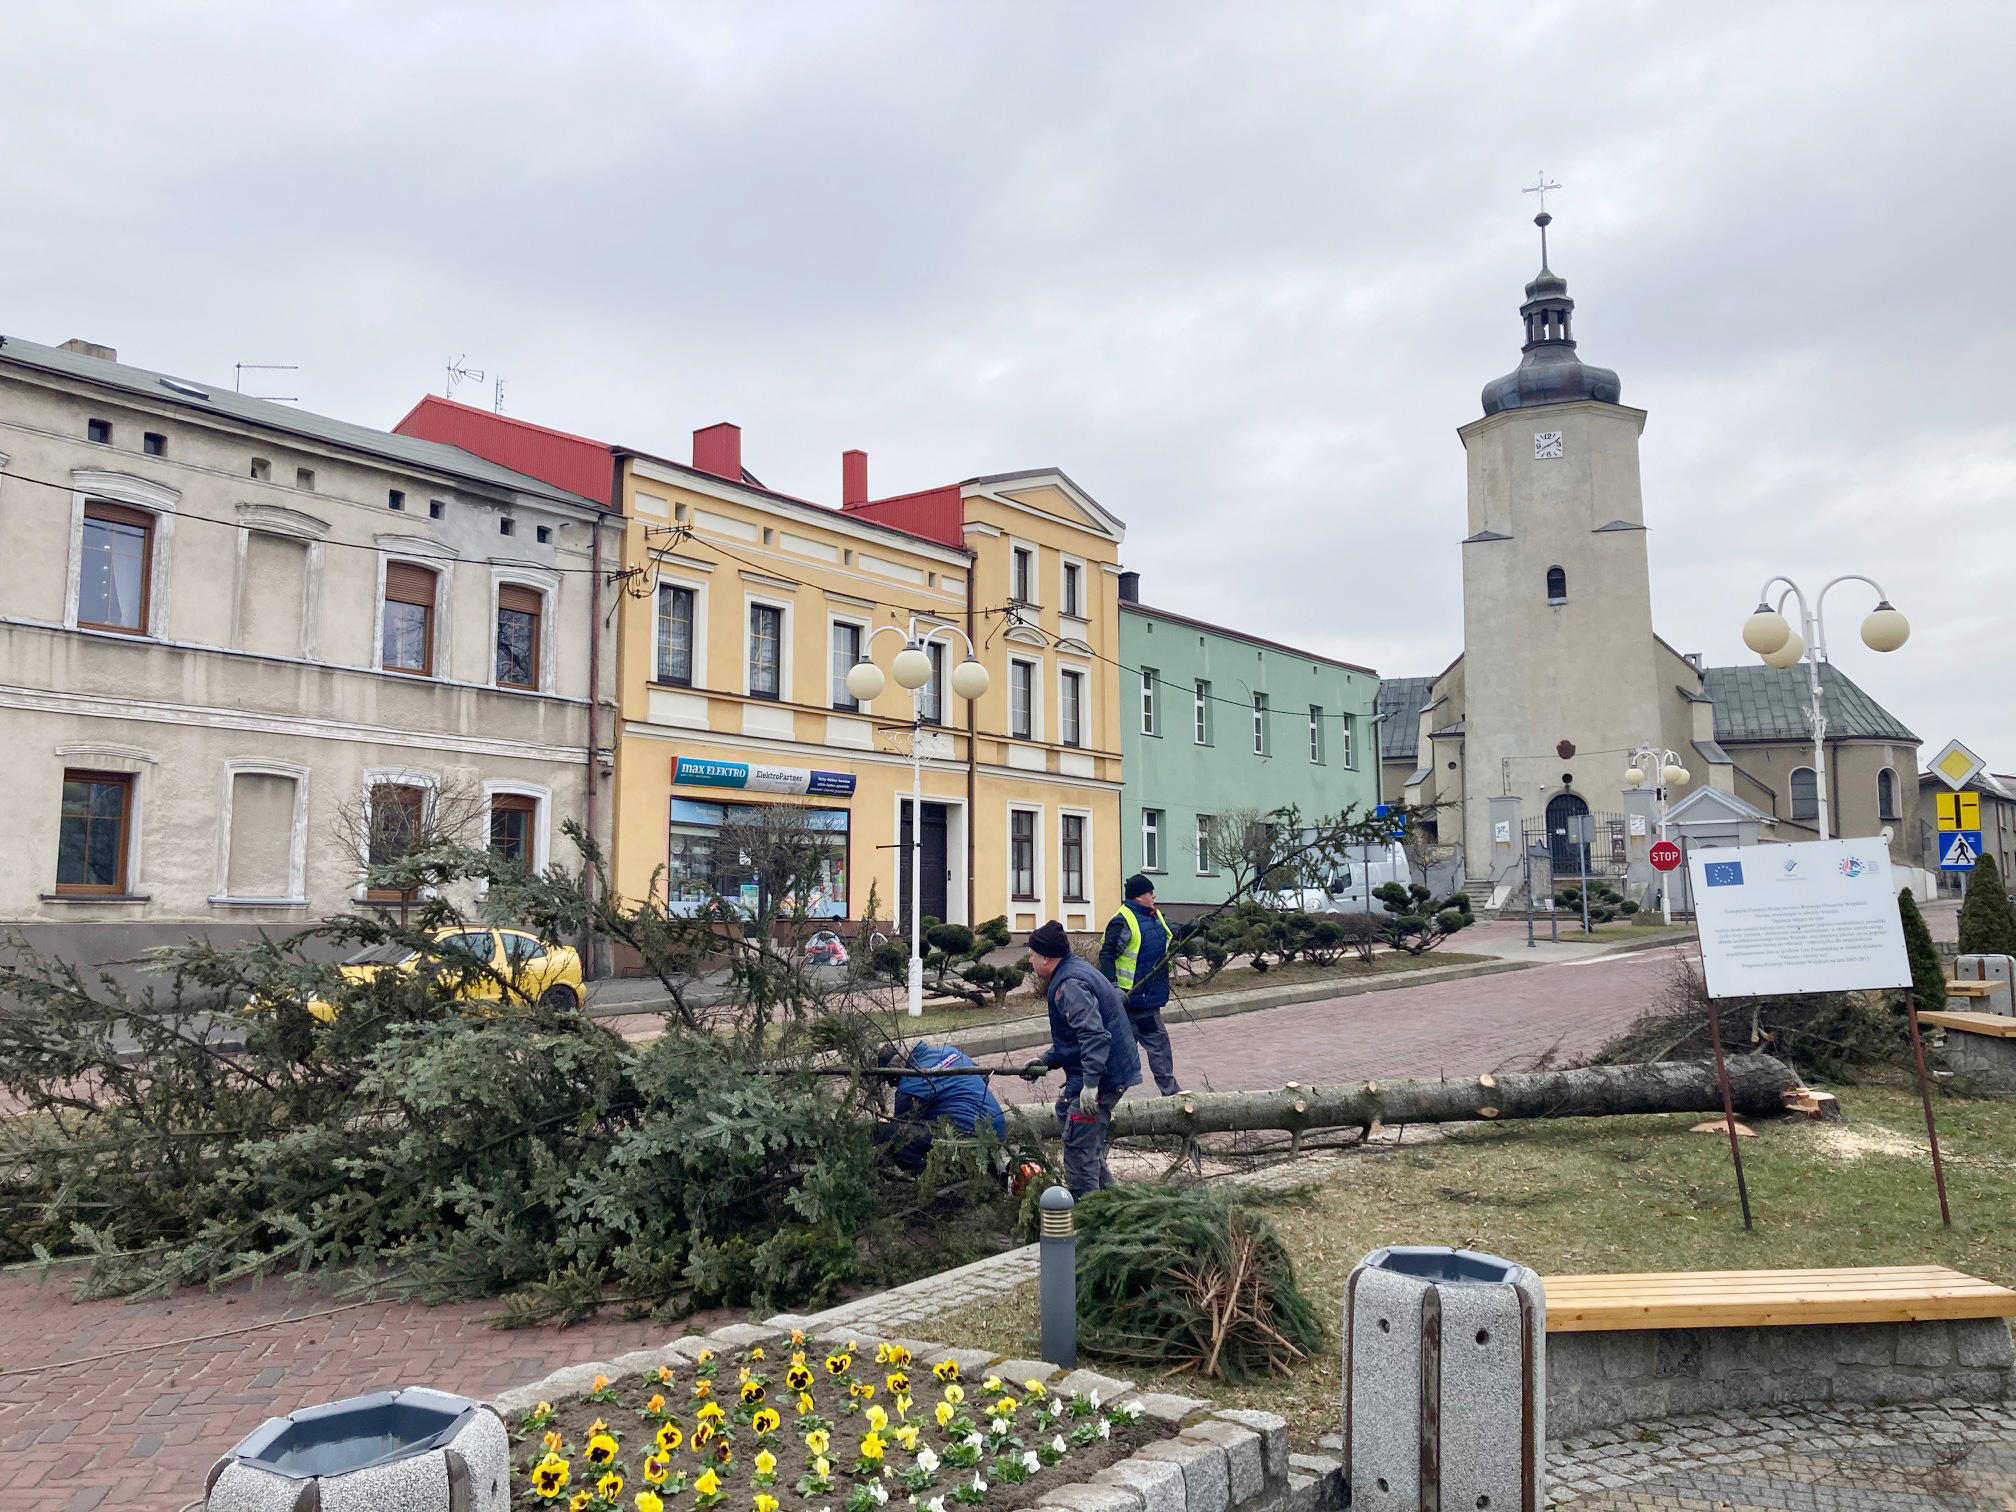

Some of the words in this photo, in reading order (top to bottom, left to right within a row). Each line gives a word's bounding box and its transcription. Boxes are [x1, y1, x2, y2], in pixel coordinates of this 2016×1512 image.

[681, 763, 705, 774] max
[706, 765, 746, 778] ELEKTRO
[756, 770, 803, 782] ElektroPartner
[1652, 851, 1678, 862] STOP
